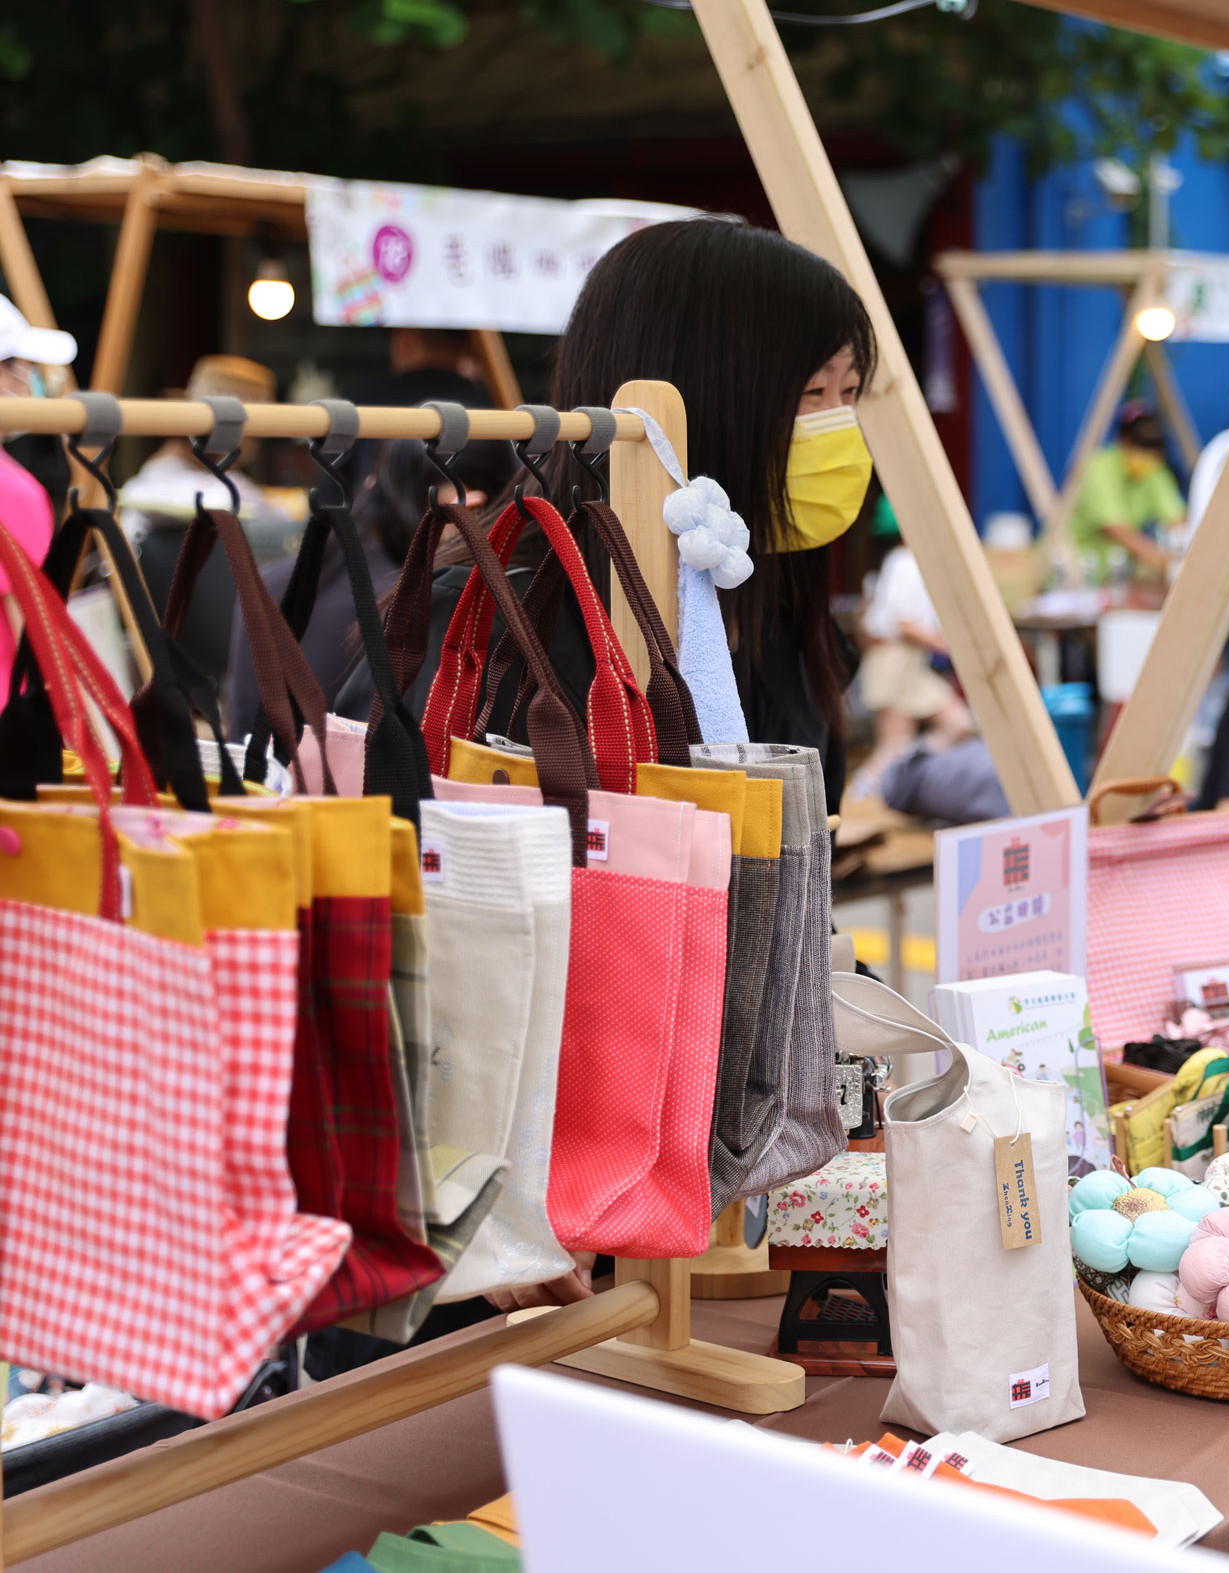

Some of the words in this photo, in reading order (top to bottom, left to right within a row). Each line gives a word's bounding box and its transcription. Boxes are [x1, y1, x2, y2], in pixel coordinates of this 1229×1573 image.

[986, 1019, 1047, 1044] American
[1014, 1159, 1030, 1208] Thank
[1020, 1211, 1033, 1240] you
